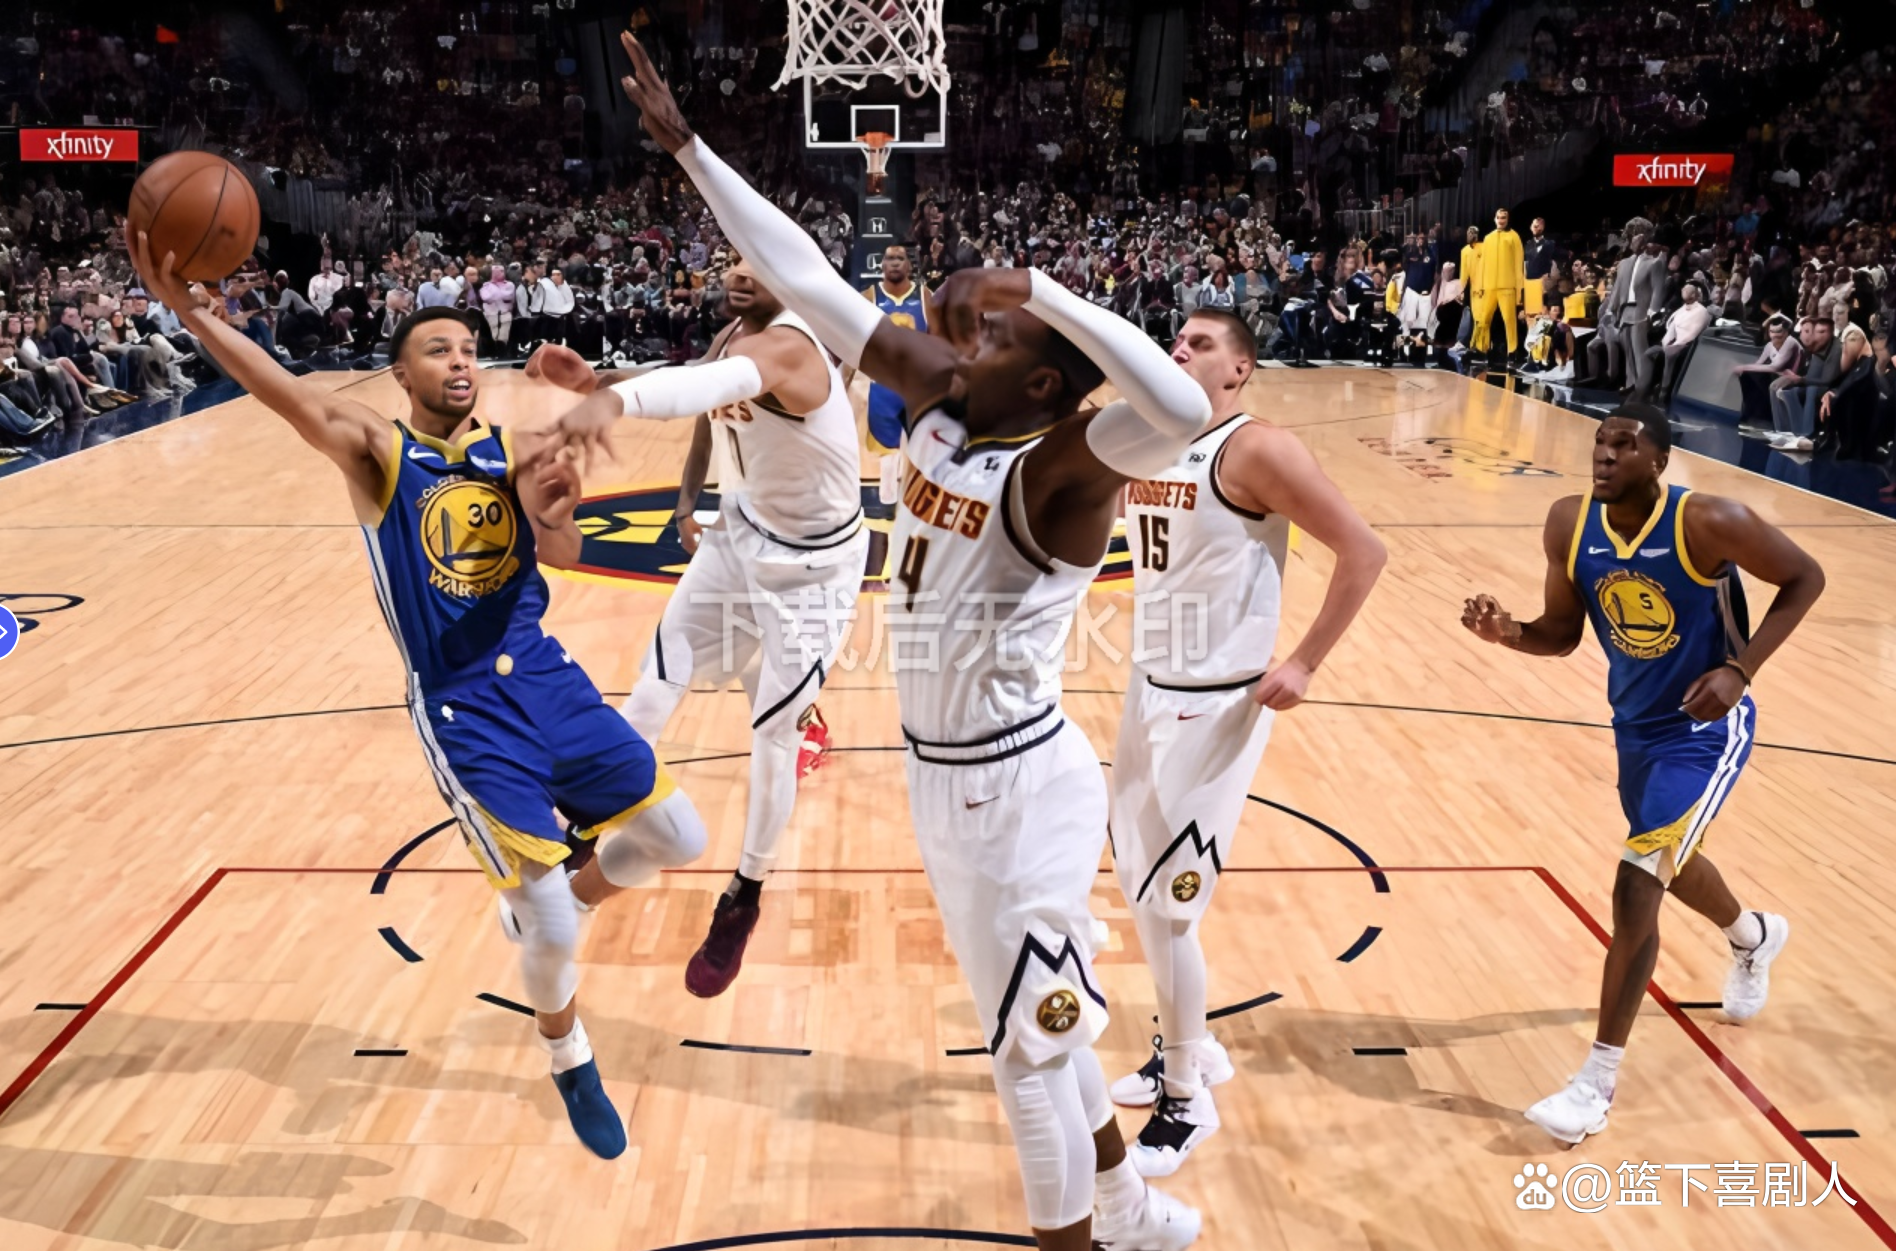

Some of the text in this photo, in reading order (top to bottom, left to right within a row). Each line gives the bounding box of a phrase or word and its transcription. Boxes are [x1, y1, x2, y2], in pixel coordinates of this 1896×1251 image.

[46, 130, 114, 160] xfinity
[1636, 155, 1706, 185] xfinity
[467, 500, 503, 529] 30
[1138, 514, 1170, 572] 15
[898, 534, 930, 613] 4
